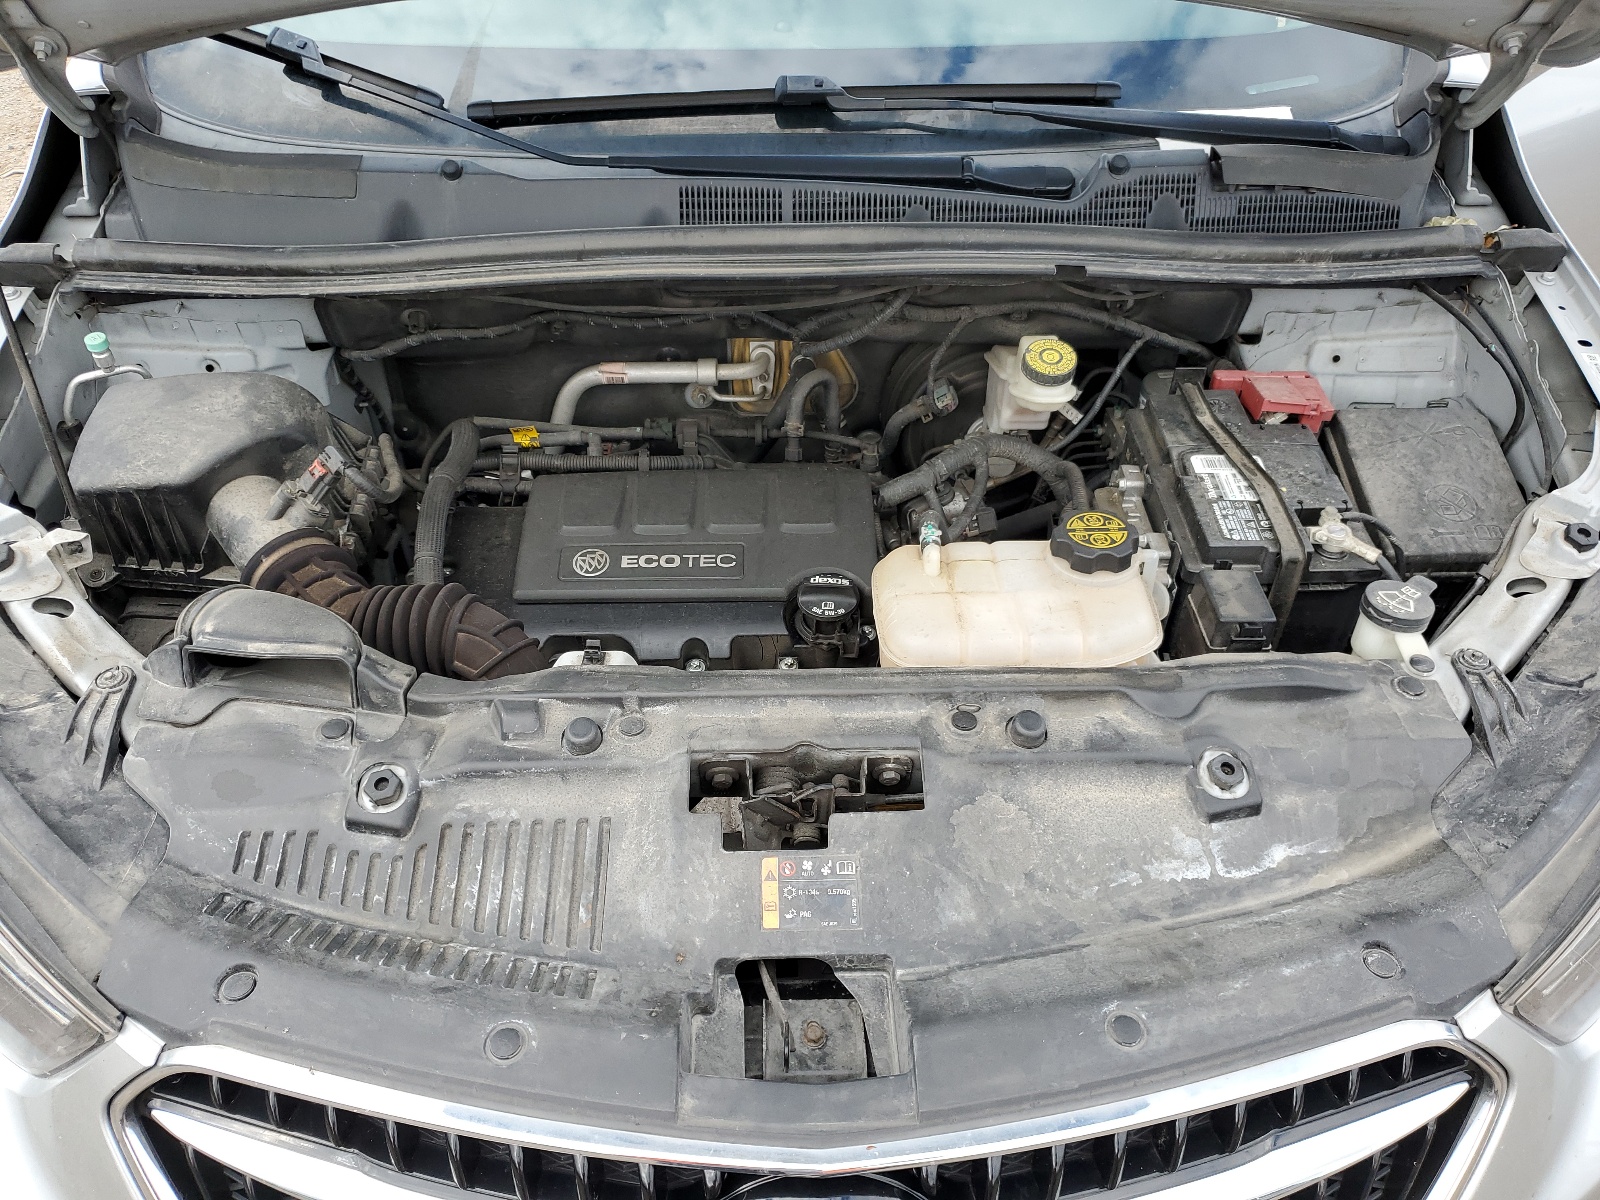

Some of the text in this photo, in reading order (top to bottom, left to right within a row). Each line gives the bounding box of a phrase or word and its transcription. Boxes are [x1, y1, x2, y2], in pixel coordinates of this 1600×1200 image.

[620, 554, 737, 568] ECOTEC
[810, 576, 850, 585] dexos
[812, 607, 823, 615] SAE
